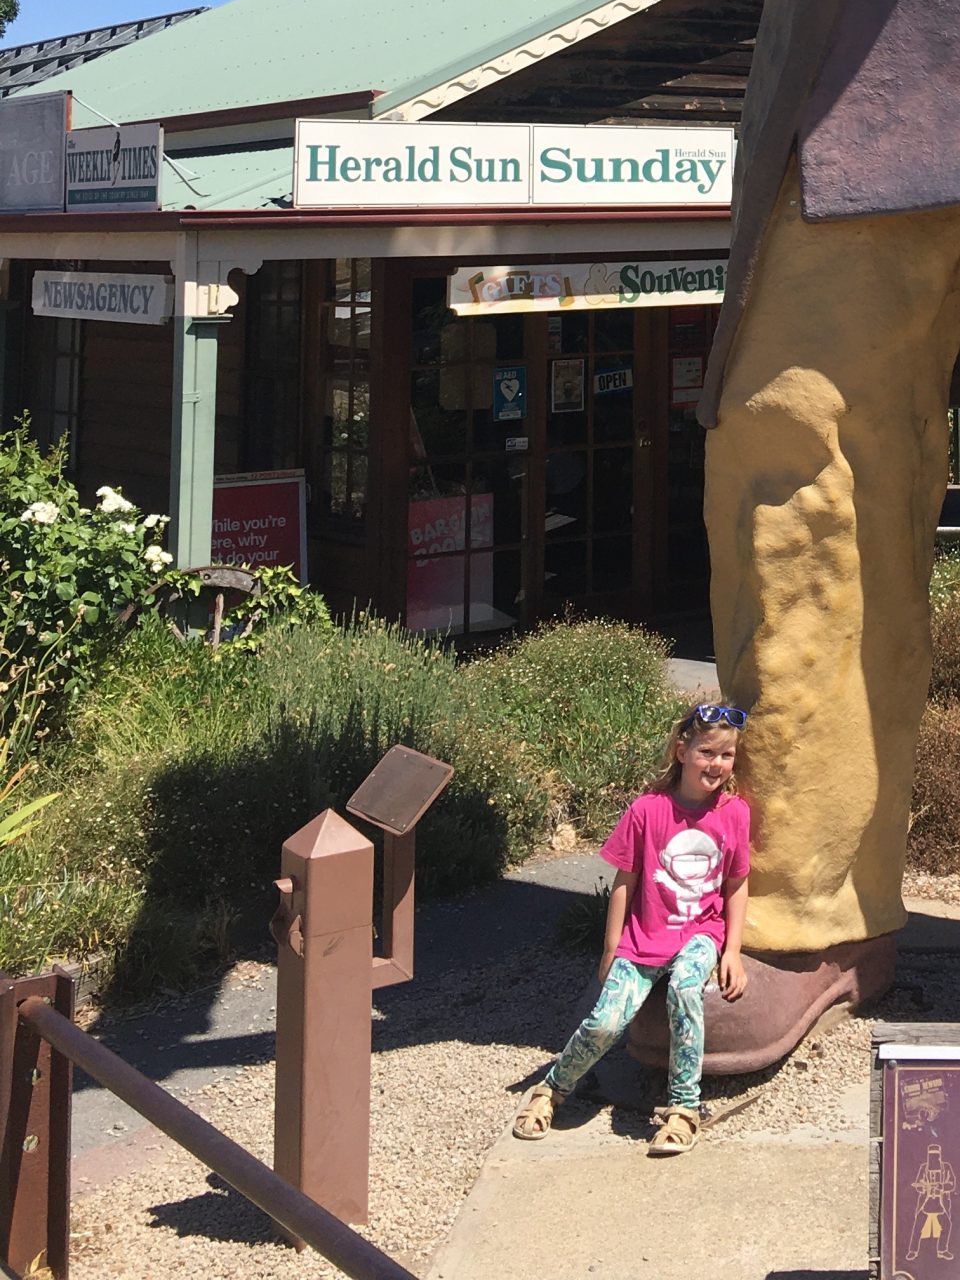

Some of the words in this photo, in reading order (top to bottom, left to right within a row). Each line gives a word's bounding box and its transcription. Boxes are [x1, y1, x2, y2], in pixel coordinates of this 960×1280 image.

[6, 150, 53, 186] AGE
[67, 148, 113, 183] WEEKLY
[121, 145, 157, 180] TIMES
[305, 145, 442, 183] Herald
[449, 146, 523, 183] Sun
[540, 147, 727, 194] Sunday
[674, 148, 706, 158] Herald
[708, 149, 727, 158] Sun
[42, 280, 155, 315] NEWSAGENCY
[481, 272, 562, 302] GIFTS
[618, 264, 727, 304] Souveni
[598, 373, 627, 391] OPEN
[211, 537, 236, 549] ere,
[238, 532, 267, 547] why
[213, 518, 240, 532] hile
[243, 515, 286, 532] you're
[226, 550, 245, 565] do
[248, 550, 279, 564] your
